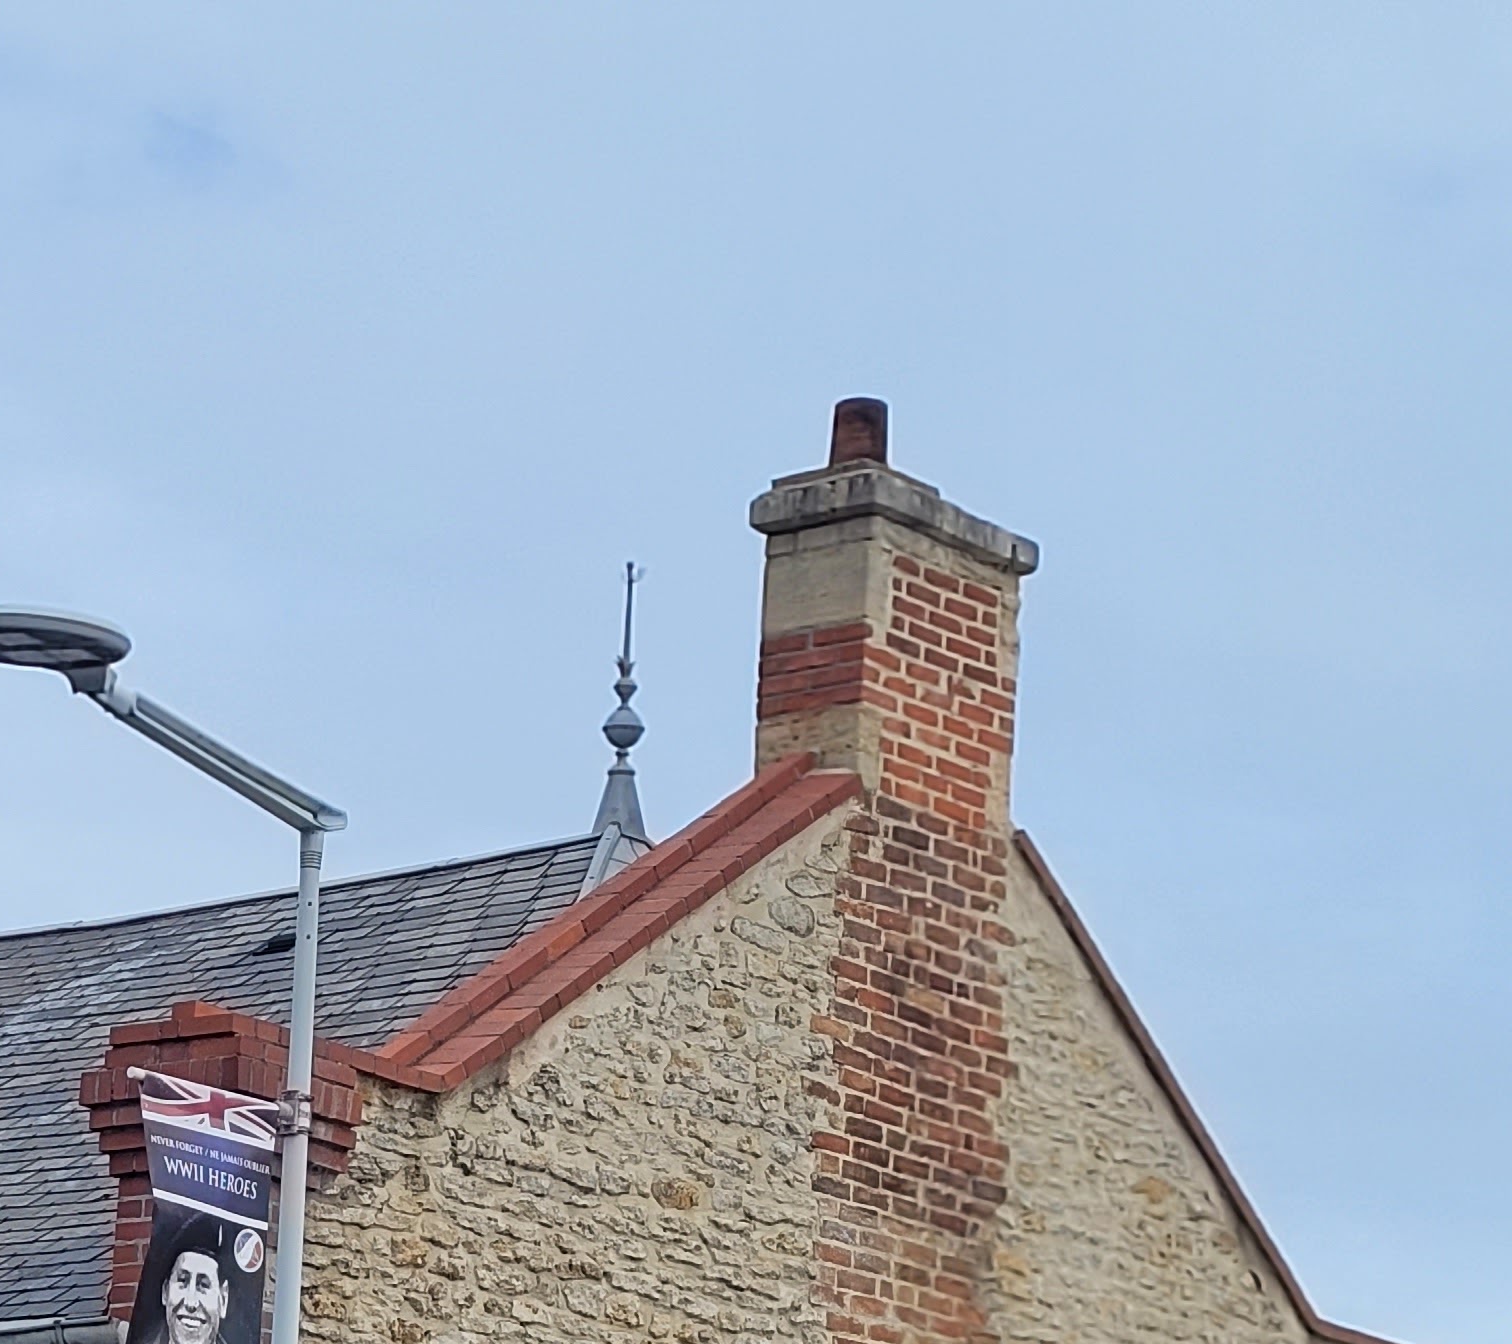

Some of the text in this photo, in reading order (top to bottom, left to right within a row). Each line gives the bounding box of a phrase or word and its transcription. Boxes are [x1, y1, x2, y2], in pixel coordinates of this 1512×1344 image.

[176, 1140, 204, 1156] FORGET
[163, 1155, 258, 1200] WWII HEROES
